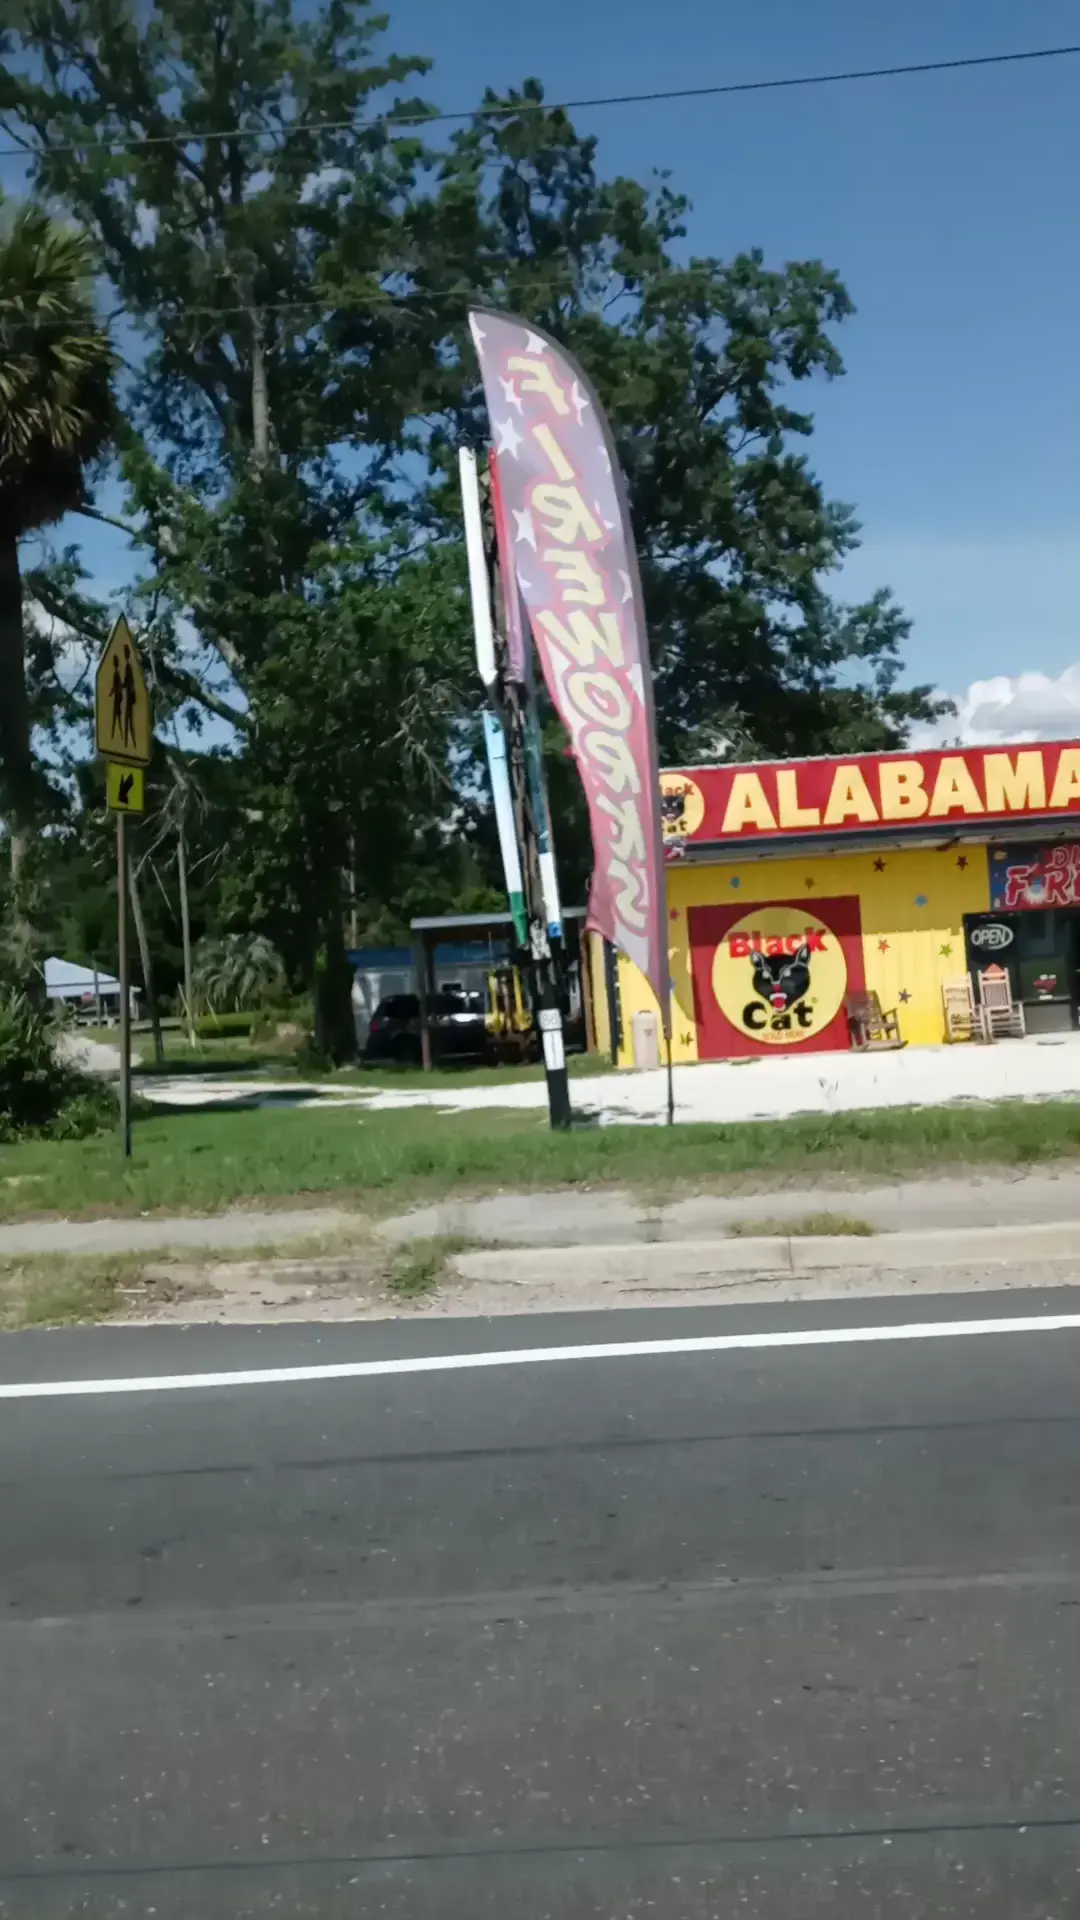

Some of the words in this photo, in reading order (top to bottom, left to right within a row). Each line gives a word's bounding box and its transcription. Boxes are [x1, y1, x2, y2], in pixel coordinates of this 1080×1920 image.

[721, 748, 1080, 833] ALABAMA
[667, 819, 688, 833] at
[728, 927, 828, 958] Black
[970, 928, 1007, 947] OPEN
[742, 999, 813, 1031] Cat
